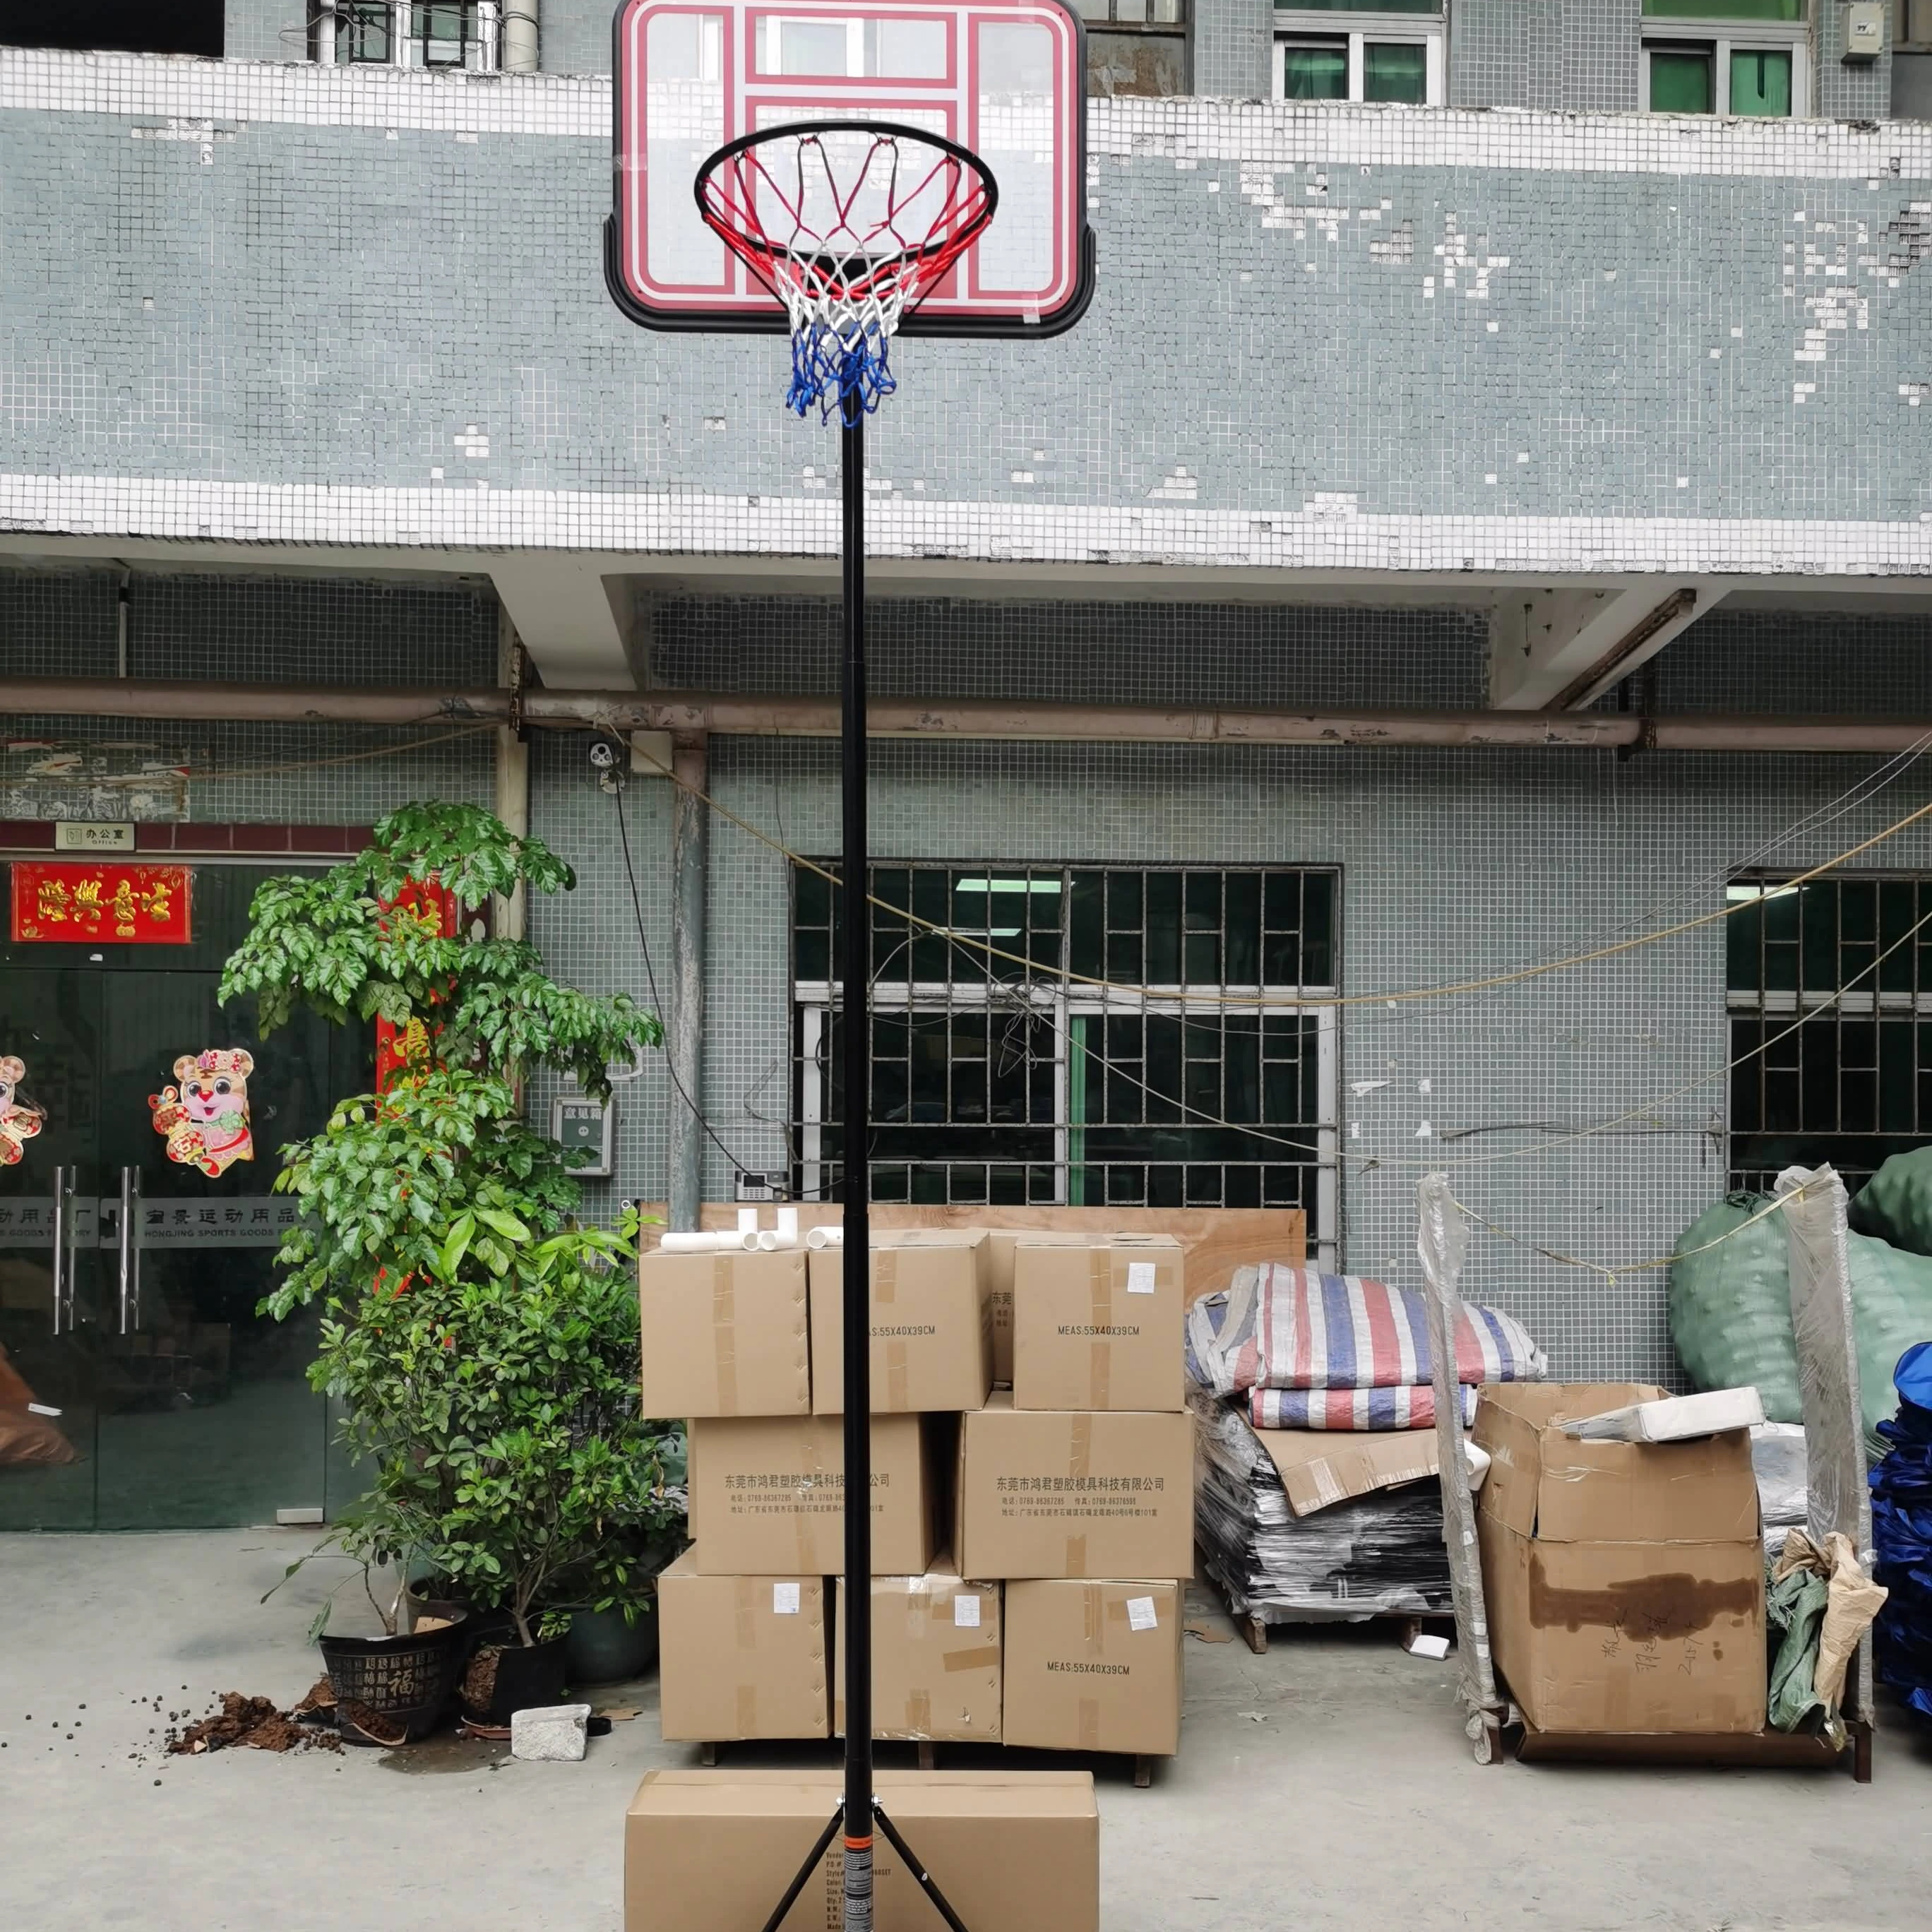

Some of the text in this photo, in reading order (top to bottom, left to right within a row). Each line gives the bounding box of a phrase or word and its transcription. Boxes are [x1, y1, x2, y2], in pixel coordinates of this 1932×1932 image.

[86, 829, 124, 839] 办公室
[564, 1107, 602, 1120] 意见箱
[145, 1229, 194, 1238] HONGJING
[869, 1325, 936, 1336] S:55X40X39CM
[724, 1474, 890, 1489] 东莞市鸿君塑胶模具科技公司
[996, 1477, 1164, 1491] 东莞市鸿君塑胶模具科技有限公司
[1047, 1662, 1130, 1675] MEAS:55X40X39CM
[388, 1669, 415, 1697] 福
